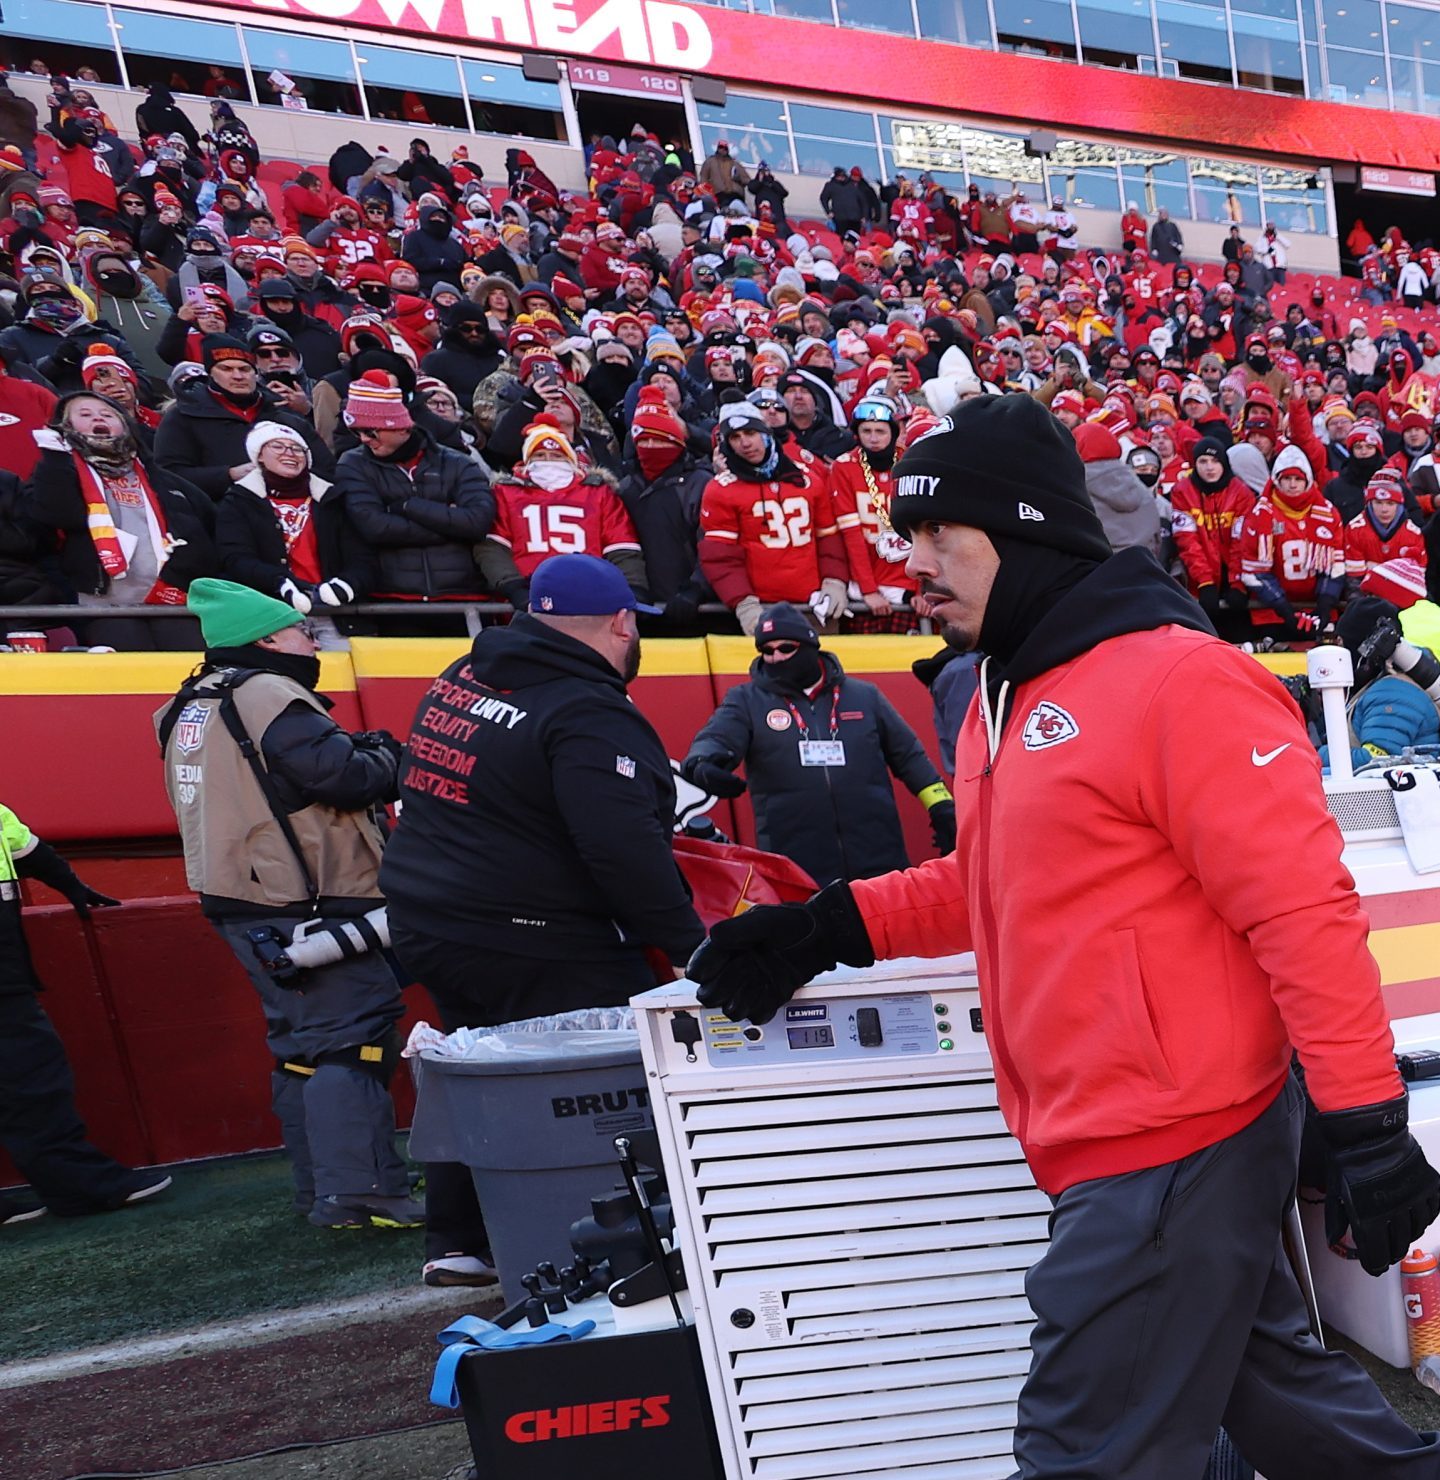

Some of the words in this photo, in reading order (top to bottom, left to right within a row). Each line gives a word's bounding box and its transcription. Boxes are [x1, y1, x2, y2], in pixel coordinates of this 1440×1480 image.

[250, 0, 713, 70] HEAD
[573, 66, 610, 82] 119
[640, 75, 678, 91] 120
[338, 238, 374, 264] 32
[522, 504, 586, 554] 15
[752, 496, 811, 549] 32
[426, 677, 528, 730] PPORTUNITY
[178, 724, 200, 746] NFL
[421, 705, 480, 742] EQUITY
[408, 733, 478, 777] FREEDOM
[403, 765, 470, 804] JUSTICE
[551, 1087, 649, 1119] BRUT
[504, 1395, 671, 1444] CHIEFS
